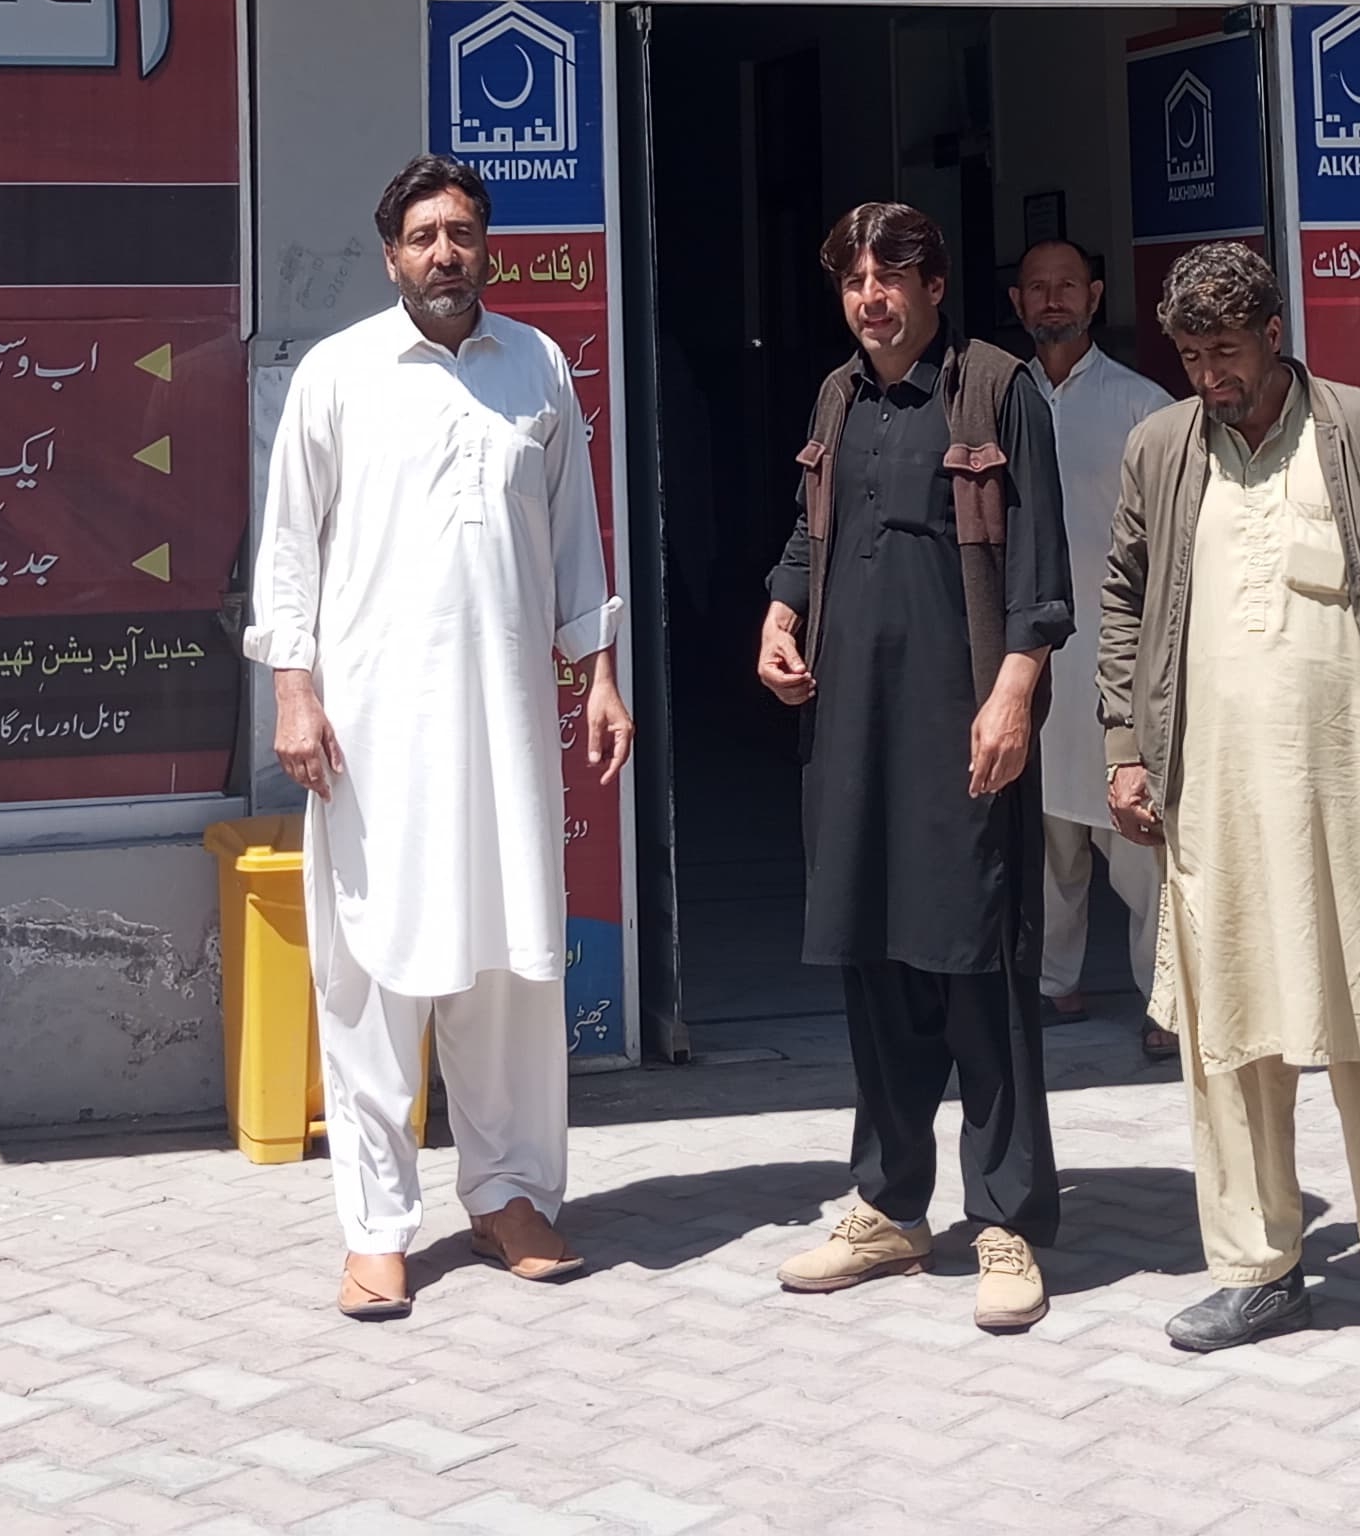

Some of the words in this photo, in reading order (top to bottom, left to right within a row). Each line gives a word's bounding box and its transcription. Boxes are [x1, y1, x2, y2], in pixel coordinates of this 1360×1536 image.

[1168, 181, 1215, 202] ALKHIDMAT
[486, 249, 521, 285] ملا
[529, 243, 594, 290] اوقات
[34, 341, 98, 390] اب
[144, 637, 206, 669] جدید
[48, 714, 78, 736] اور
[79, 704, 130, 739] قابل
